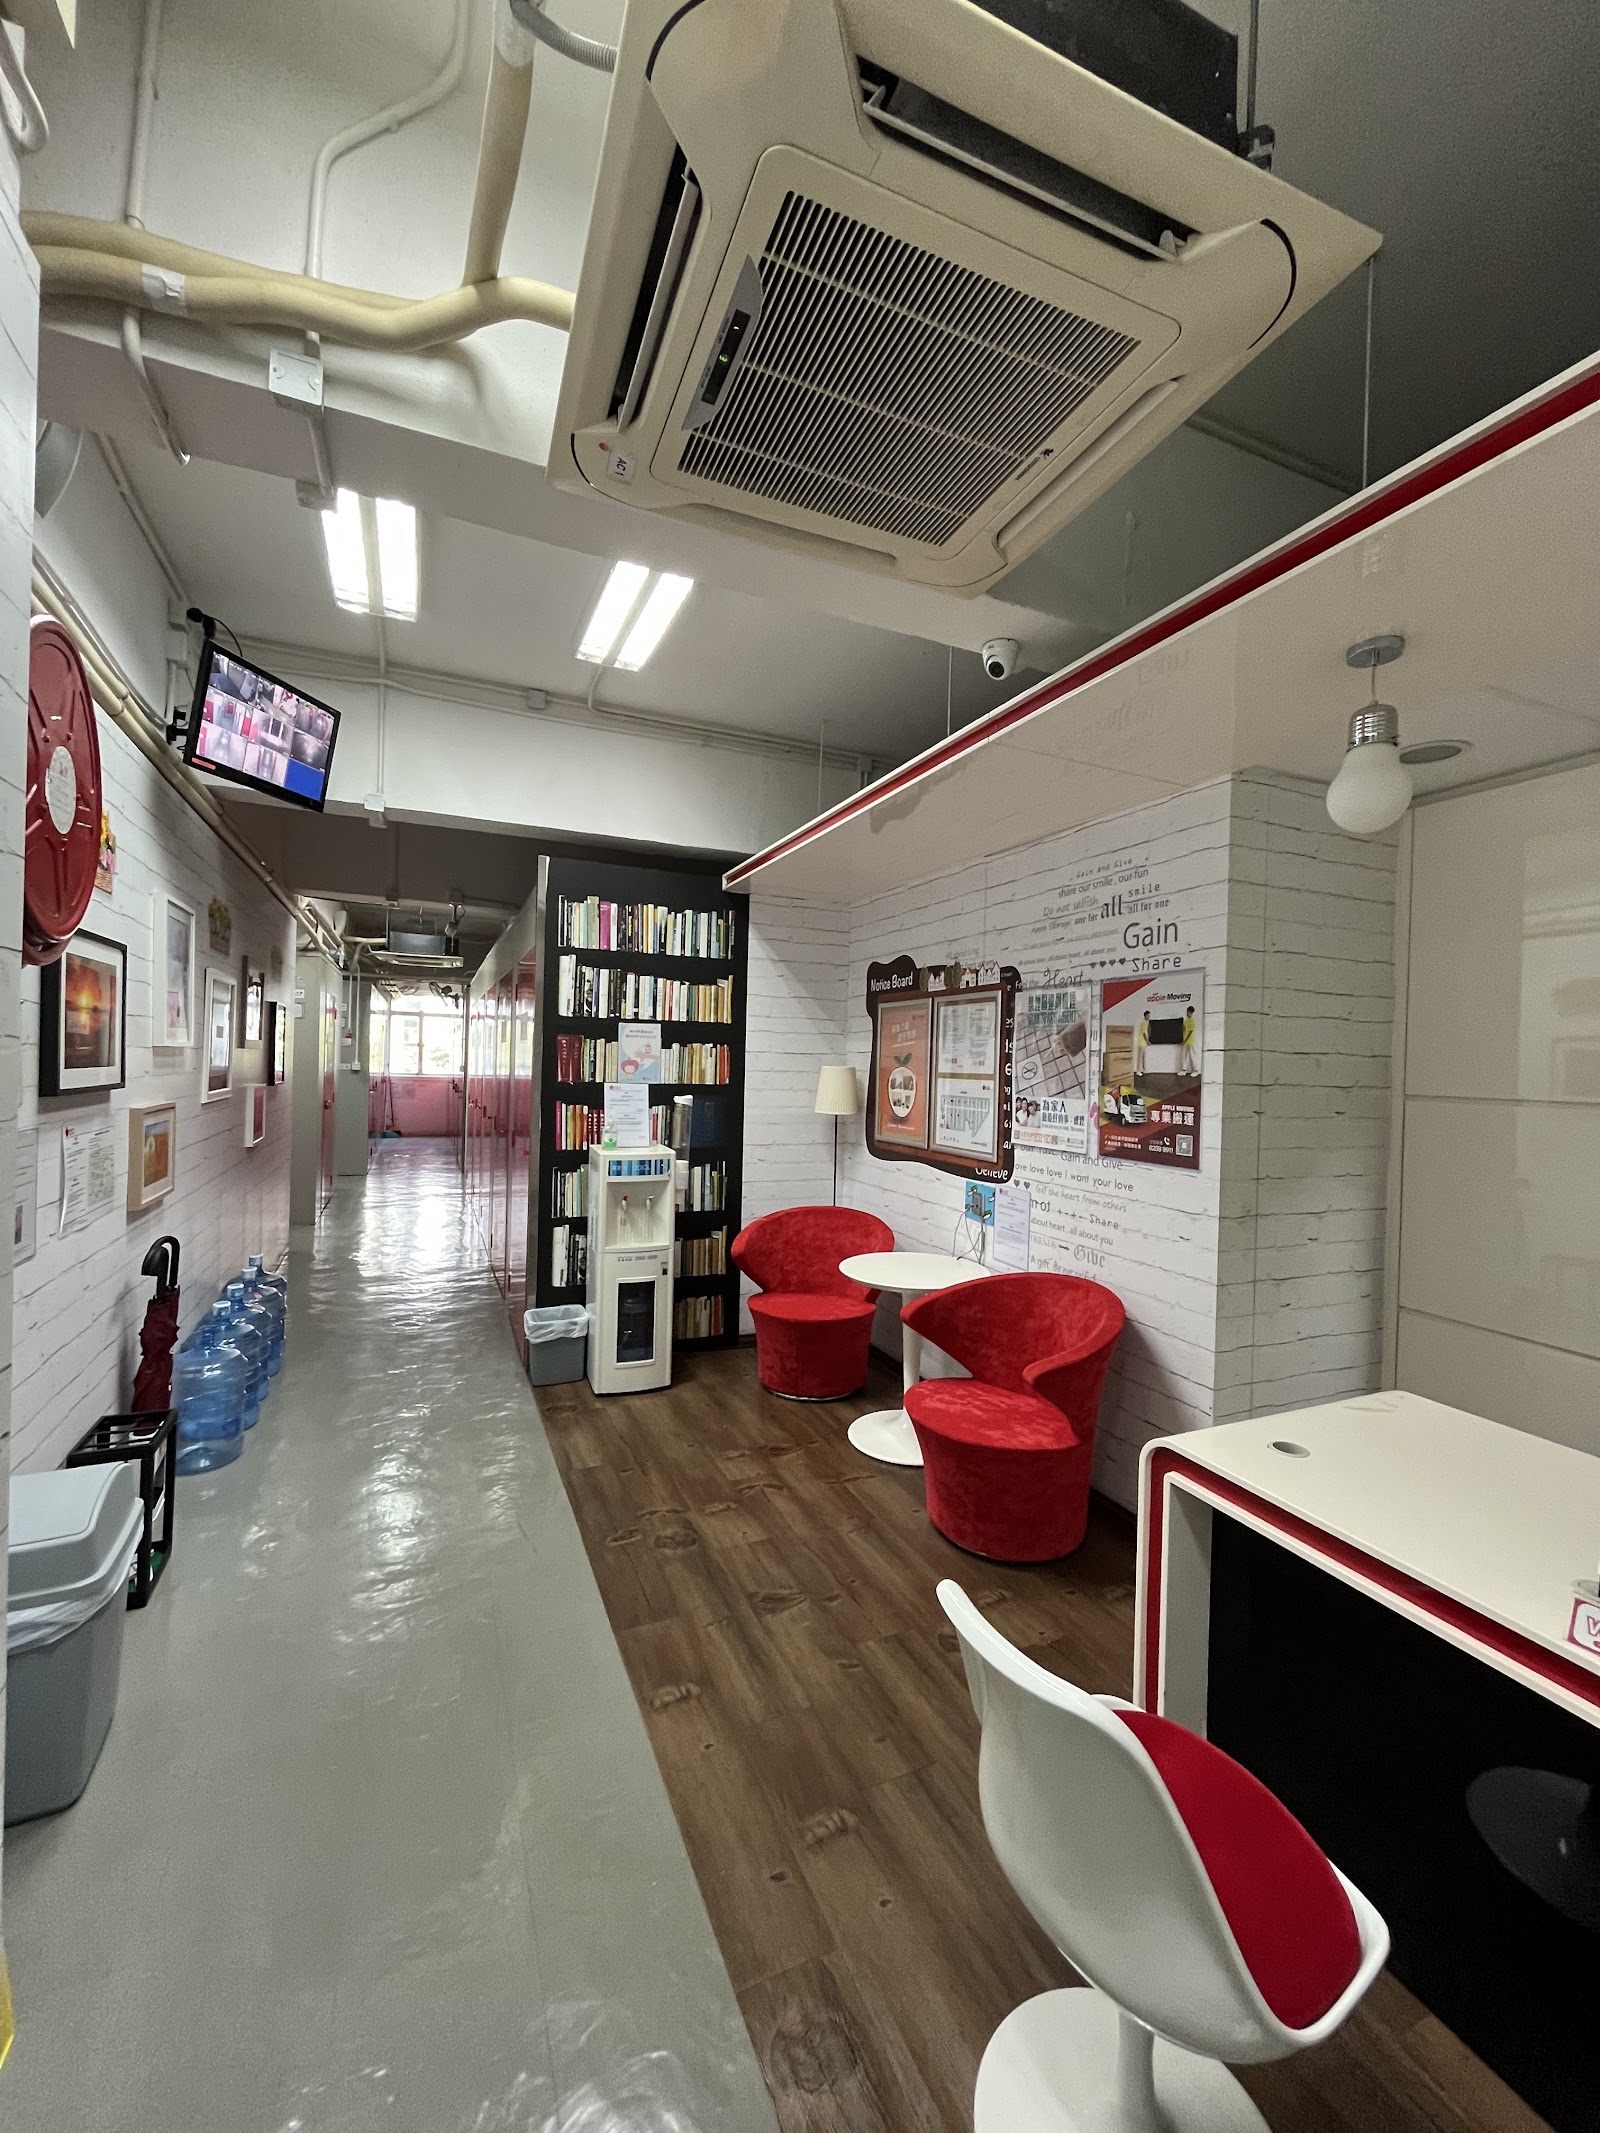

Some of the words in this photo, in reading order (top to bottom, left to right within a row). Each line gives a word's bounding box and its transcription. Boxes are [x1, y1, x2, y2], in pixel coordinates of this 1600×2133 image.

[1114, 858, 1132, 868] Give
[1058, 888, 1077, 898] share
[1078, 883, 1091, 893] our
[1119, 873, 1132, 883] our
[1134, 869, 1149, 879] fun
[1128, 883, 1160, 898] smile
[1043, 906, 1054, 917] Do
[1056, 904, 1070, 914] not
[1074, 916, 1086, 925] one
[1088, 913, 1099, 922] for
[1141, 902, 1152, 911] for
[1155, 899, 1169, 908] one
[1123, 918, 1178, 949] Gain
[1132, 956, 1181, 972] Share
[871, 978, 891, 992] Notice
[892, 971, 913, 988] Board
[1042, 967, 1084, 990] Heart
[1167, 992, 1191, 1002] Moving
[1150, 1110, 1195, 1126] 專業搬運
[1061, 1150, 1080, 1164] Gain
[1083, 1155, 1099, 1167] and
[1102, 1157, 1122, 1170] Give
[1015, 1163, 1027, 1172] ove
[1030, 1163, 1045, 1175] love
[1046, 1166, 1062, 1178] love
[1070, 1174, 1090, 1183] want
[1092, 1178, 1111, 1189] your
[1115, 1181, 1134, 1192] love
[1048, 1188, 1059, 1197] the
[1061, 1190, 1080, 1202] heart
[1082, 1194, 1100, 1207] from
[1102, 1201, 1127, 1212] others
[1031, 1217, 1048, 1228] about
[1078, 1229, 1098, 1242] about
[1100, 1237, 1114, 1248] you
[1089, 1214, 1119, 1230] Share
[1074, 1244, 1106, 1268] Give
